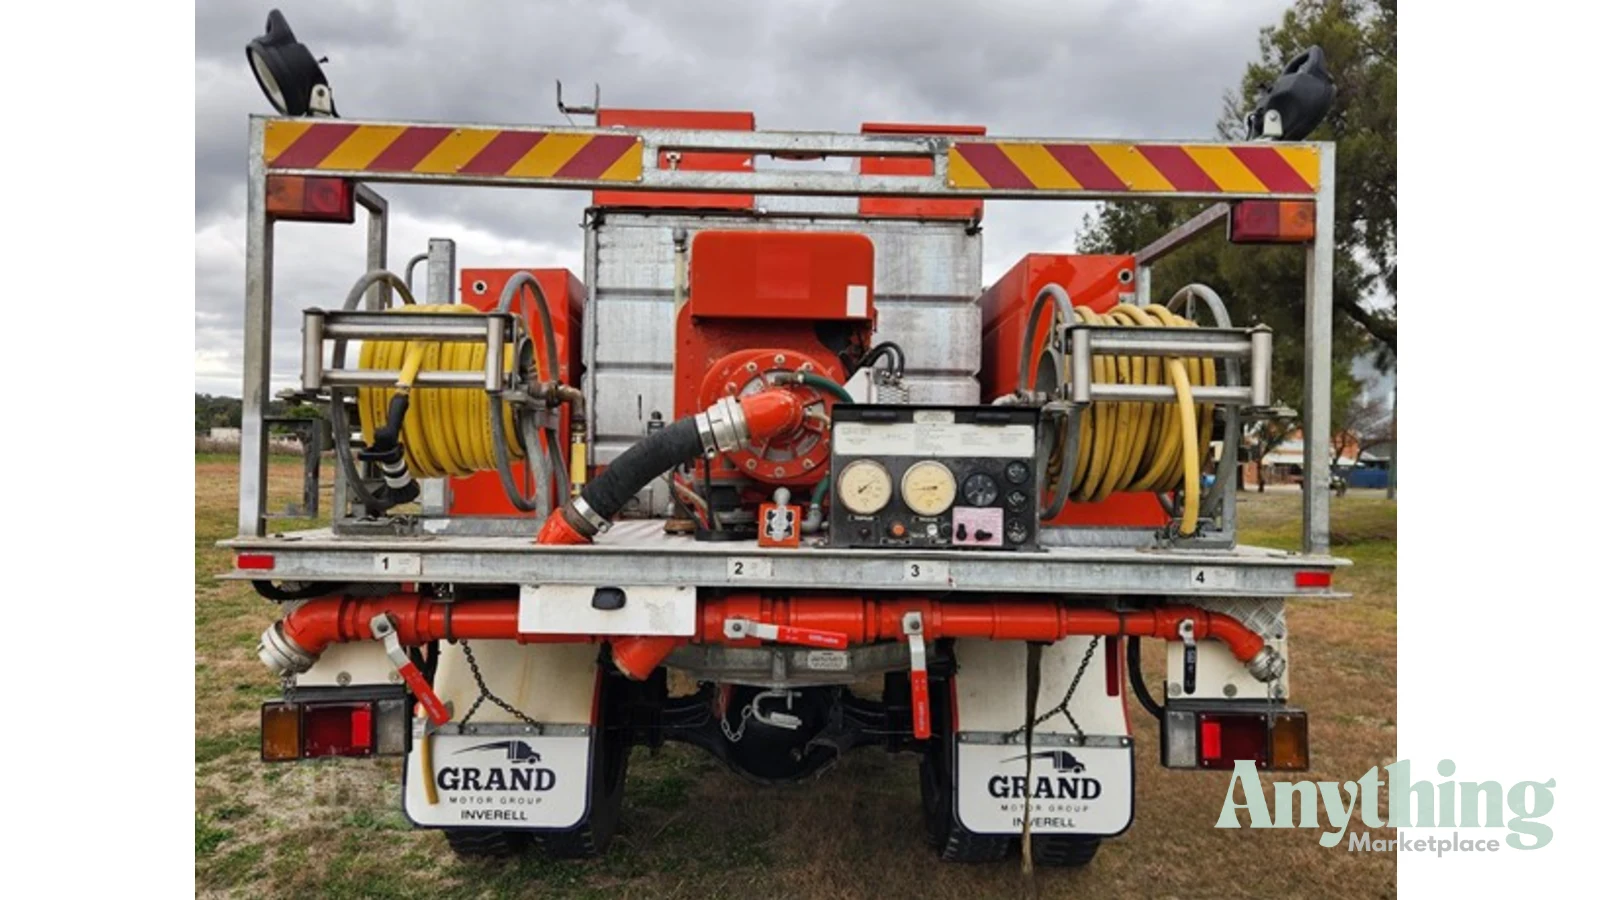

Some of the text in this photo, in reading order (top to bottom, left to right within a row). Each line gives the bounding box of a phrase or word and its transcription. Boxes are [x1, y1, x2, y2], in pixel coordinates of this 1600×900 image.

[381, 556, 390, 570] 1
[734, 561, 744, 575] 2
[910, 564, 920, 577] 3
[1195, 570, 1205, 584] 4
[437, 766, 556, 791] GRAND
[988, 774, 1102, 800] GRAND
[449, 796, 543, 805] MOTOR GROUP
[1048, 804, 1089, 812] GROUP
[461, 810, 529, 821] INVERELL
